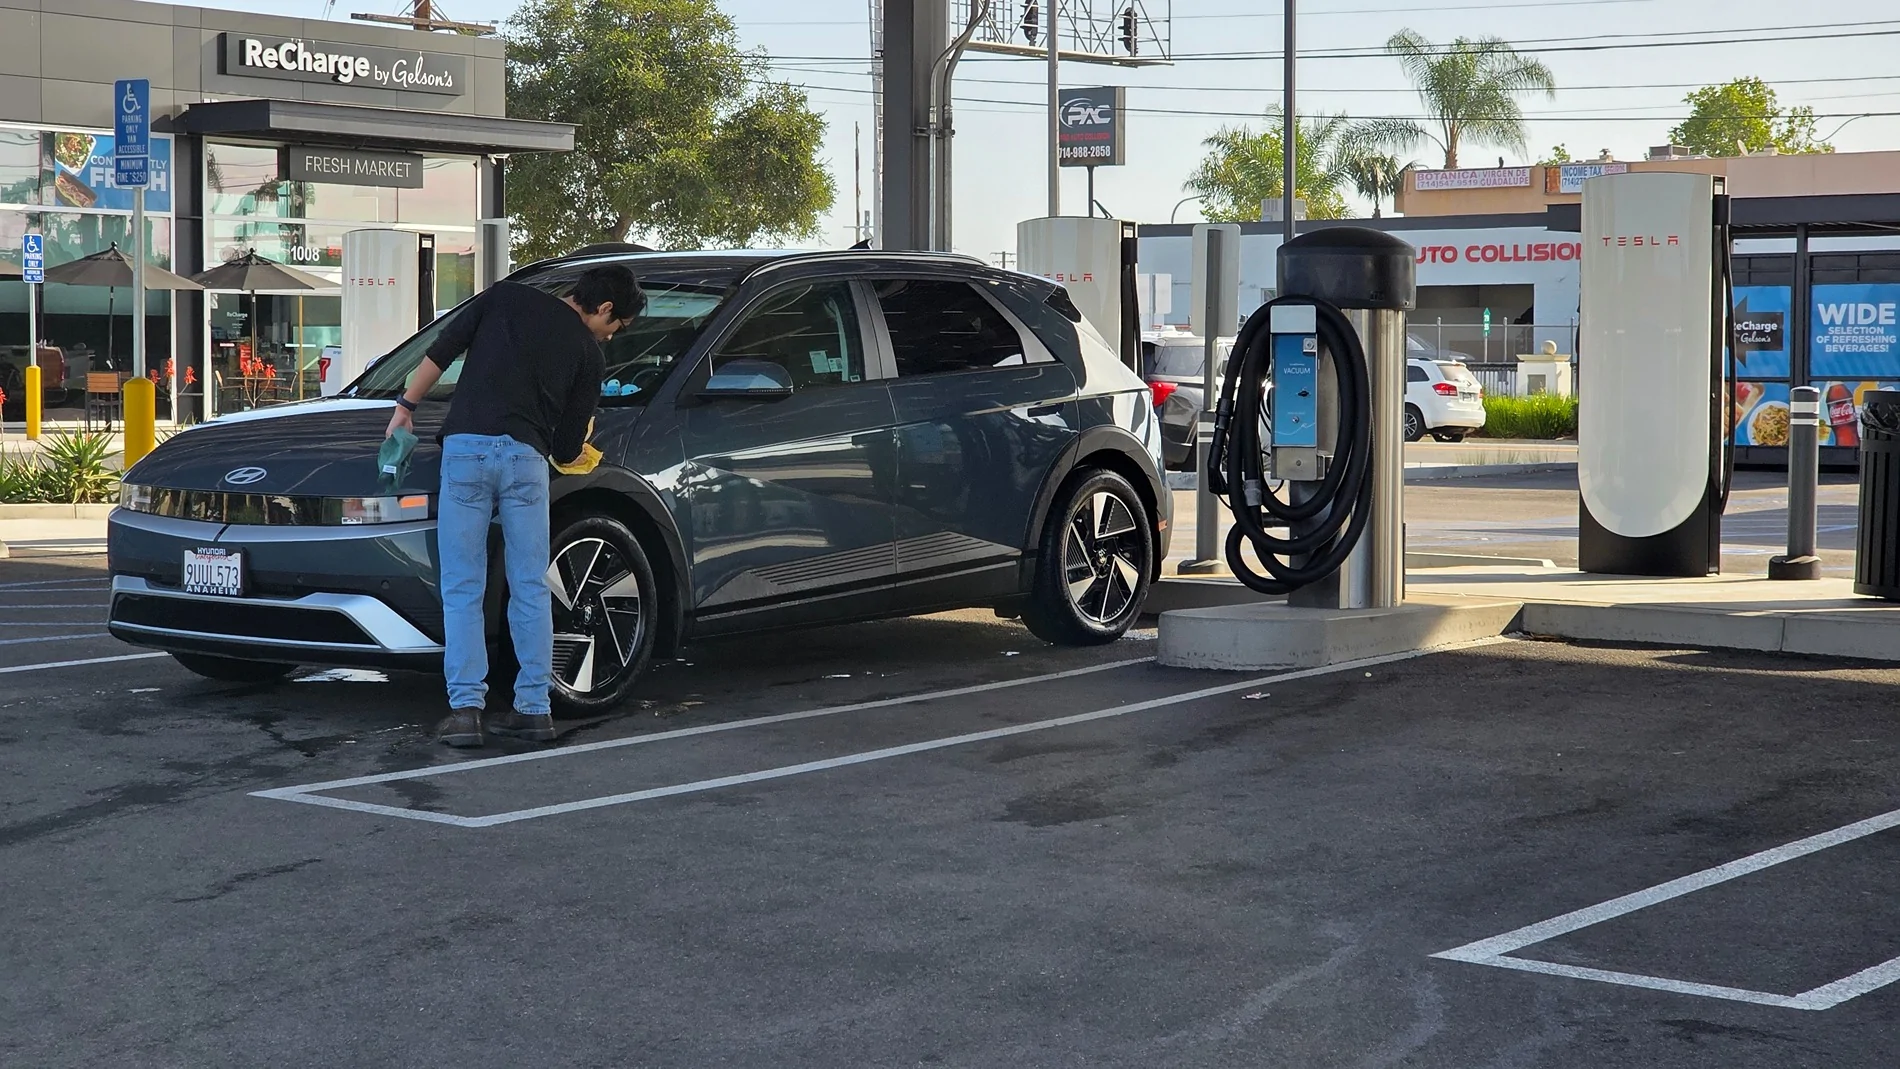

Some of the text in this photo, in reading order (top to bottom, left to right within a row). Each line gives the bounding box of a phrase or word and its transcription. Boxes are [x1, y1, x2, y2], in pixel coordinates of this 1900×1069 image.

[245, 39, 453, 88] ReCharge by Gelson's
[122, 115, 142, 124] PARKING
[1066, 104, 1111, 125] PAC
[126, 124, 138, 133] ONLY
[127, 135, 137, 143] VAN
[118, 145, 146, 154] ACCESSIBLE
[1059, 145, 1111, 158] 714-988-2858
[121, 160, 143, 170] MINIMUM
[305, 155, 412, 178] FRESH MARKET
[1482, 168, 1526, 178] VIRGEN DE
[1562, 166, 1587, 176] INCOME
[1589, 165, 1602, 175] TAX
[90, 167, 166, 191] FRH
[117, 172, 128, 182] FINE
[1417, 171, 1477, 181] BOTANICA
[1480, 177, 1529, 186] GUADALUPE
[1602, 236, 1678, 246] TESLA
[290, 246, 320, 262] 1008
[1416, 243, 1581, 264] UTO COLLISIO
[350, 278, 395, 286] TESLA
[1818, 303, 1897, 325] WIDE
[1828, 326, 1885, 335] SELECTION
[1740, 331, 1771, 344] Gelson's
[1816, 335, 1897, 344] OF REFRESHING
[1825, 344, 1889, 353] BEVERAGES!
[197, 547, 226, 555] HYUNDAI
[186, 564, 239, 588] 9UUL573
[186, 585, 238, 595] ANAHEIM
